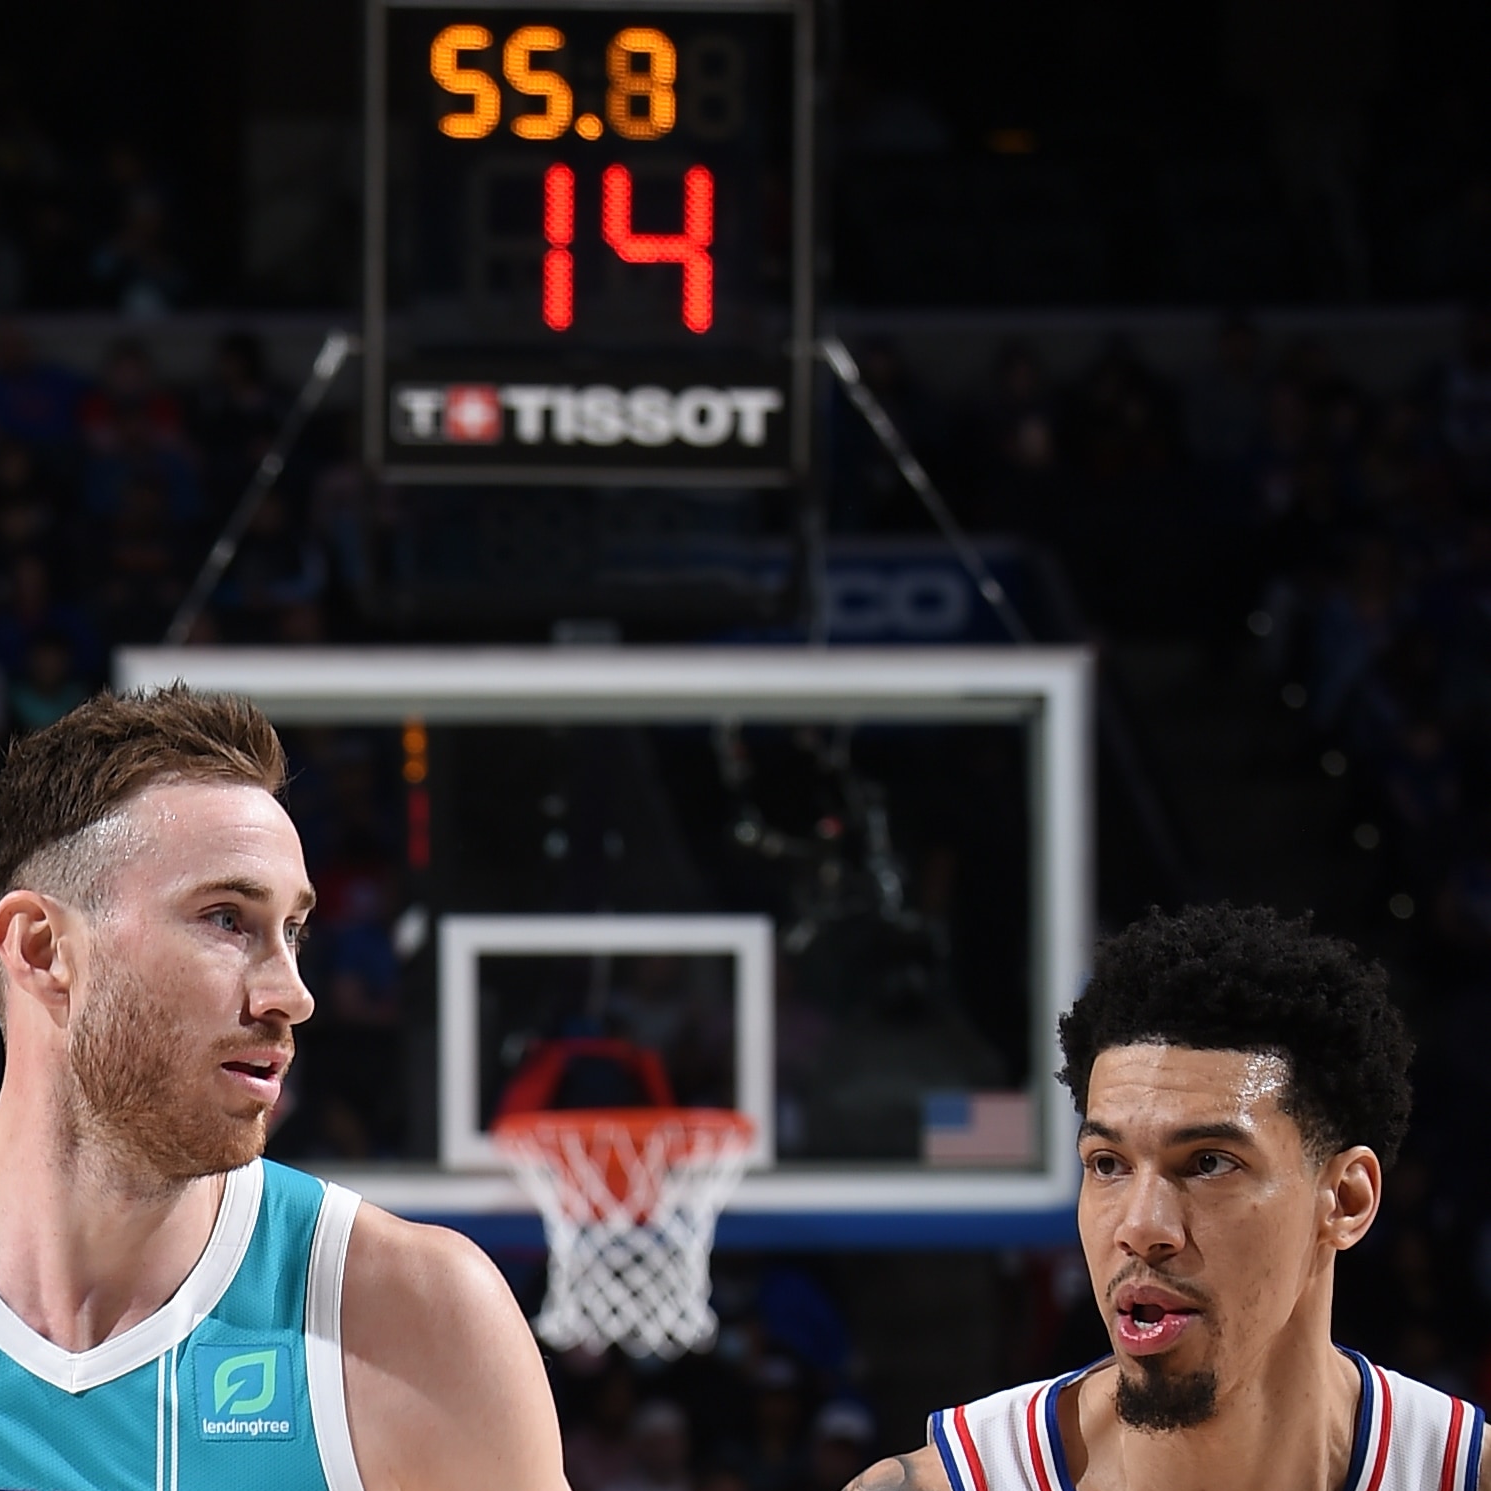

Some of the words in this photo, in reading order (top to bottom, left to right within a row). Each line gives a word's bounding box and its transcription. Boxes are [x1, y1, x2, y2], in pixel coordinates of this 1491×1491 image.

[429, 23, 677, 141] 55.8
[542, 161, 715, 334] 14
[500, 386, 783, 445] TISSOT
[202, 1417, 290, 1436] lendingtree
